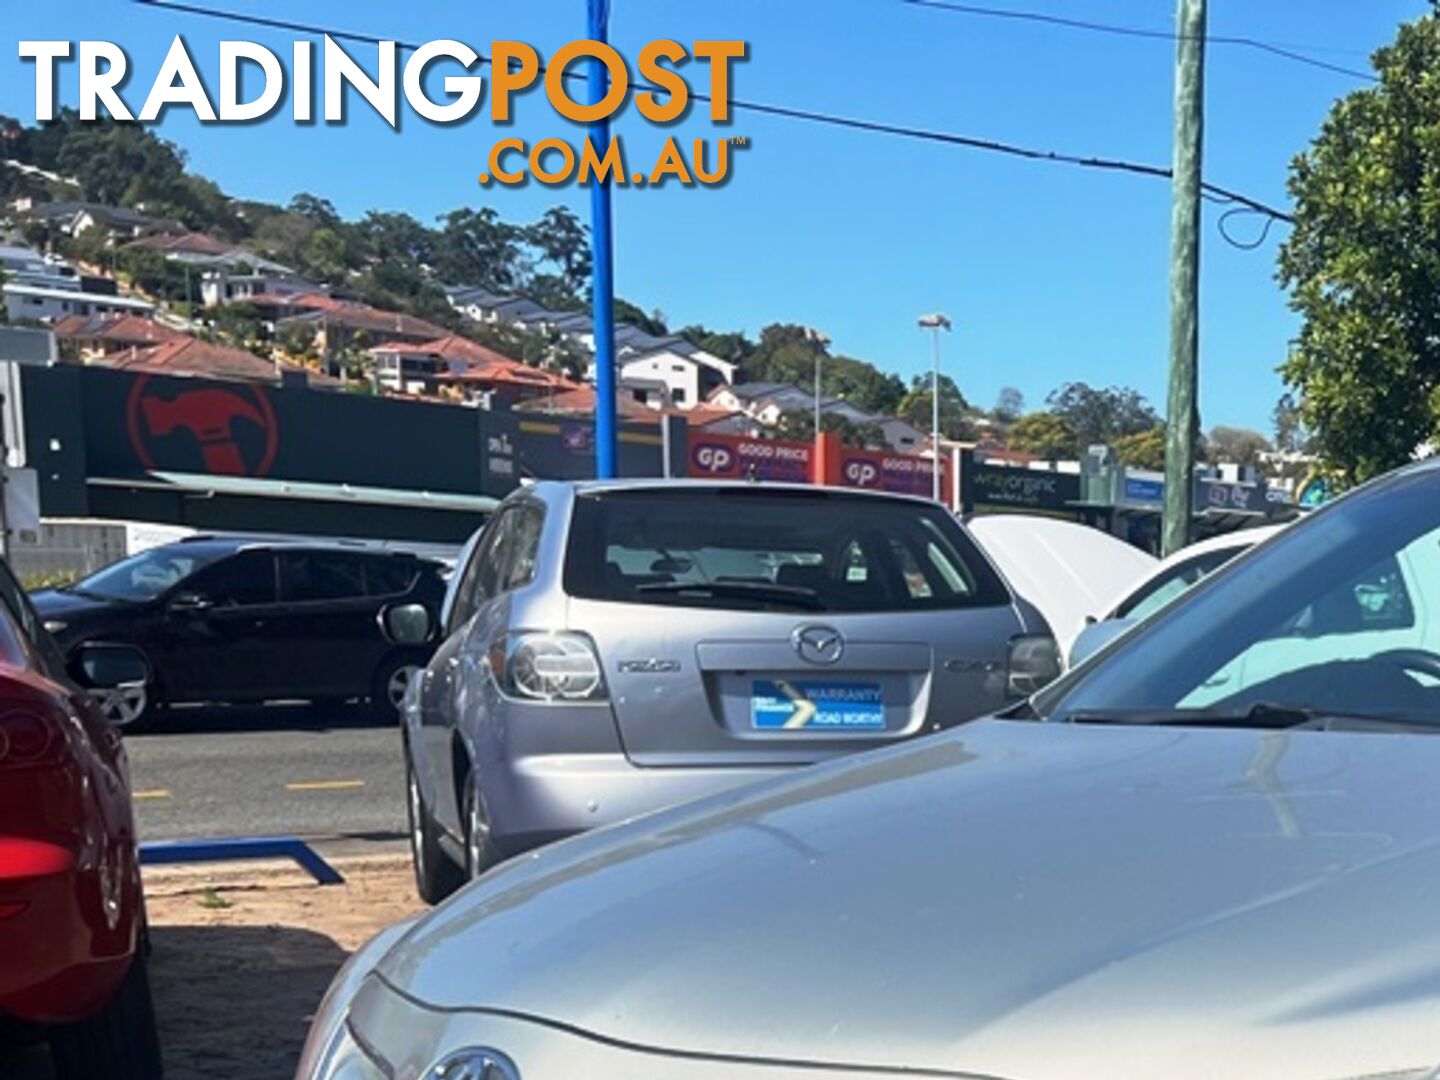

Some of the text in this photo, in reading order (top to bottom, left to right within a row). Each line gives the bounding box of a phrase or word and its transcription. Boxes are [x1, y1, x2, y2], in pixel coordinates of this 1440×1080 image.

[697, 448, 730, 472] GP
[738, 443, 774, 457] GOOD
[775, 446, 809, 462] PRICE
[846, 463, 876, 485] GP
[882, 458, 913, 471] GOOD
[804, 688, 881, 701] WARRANTY
